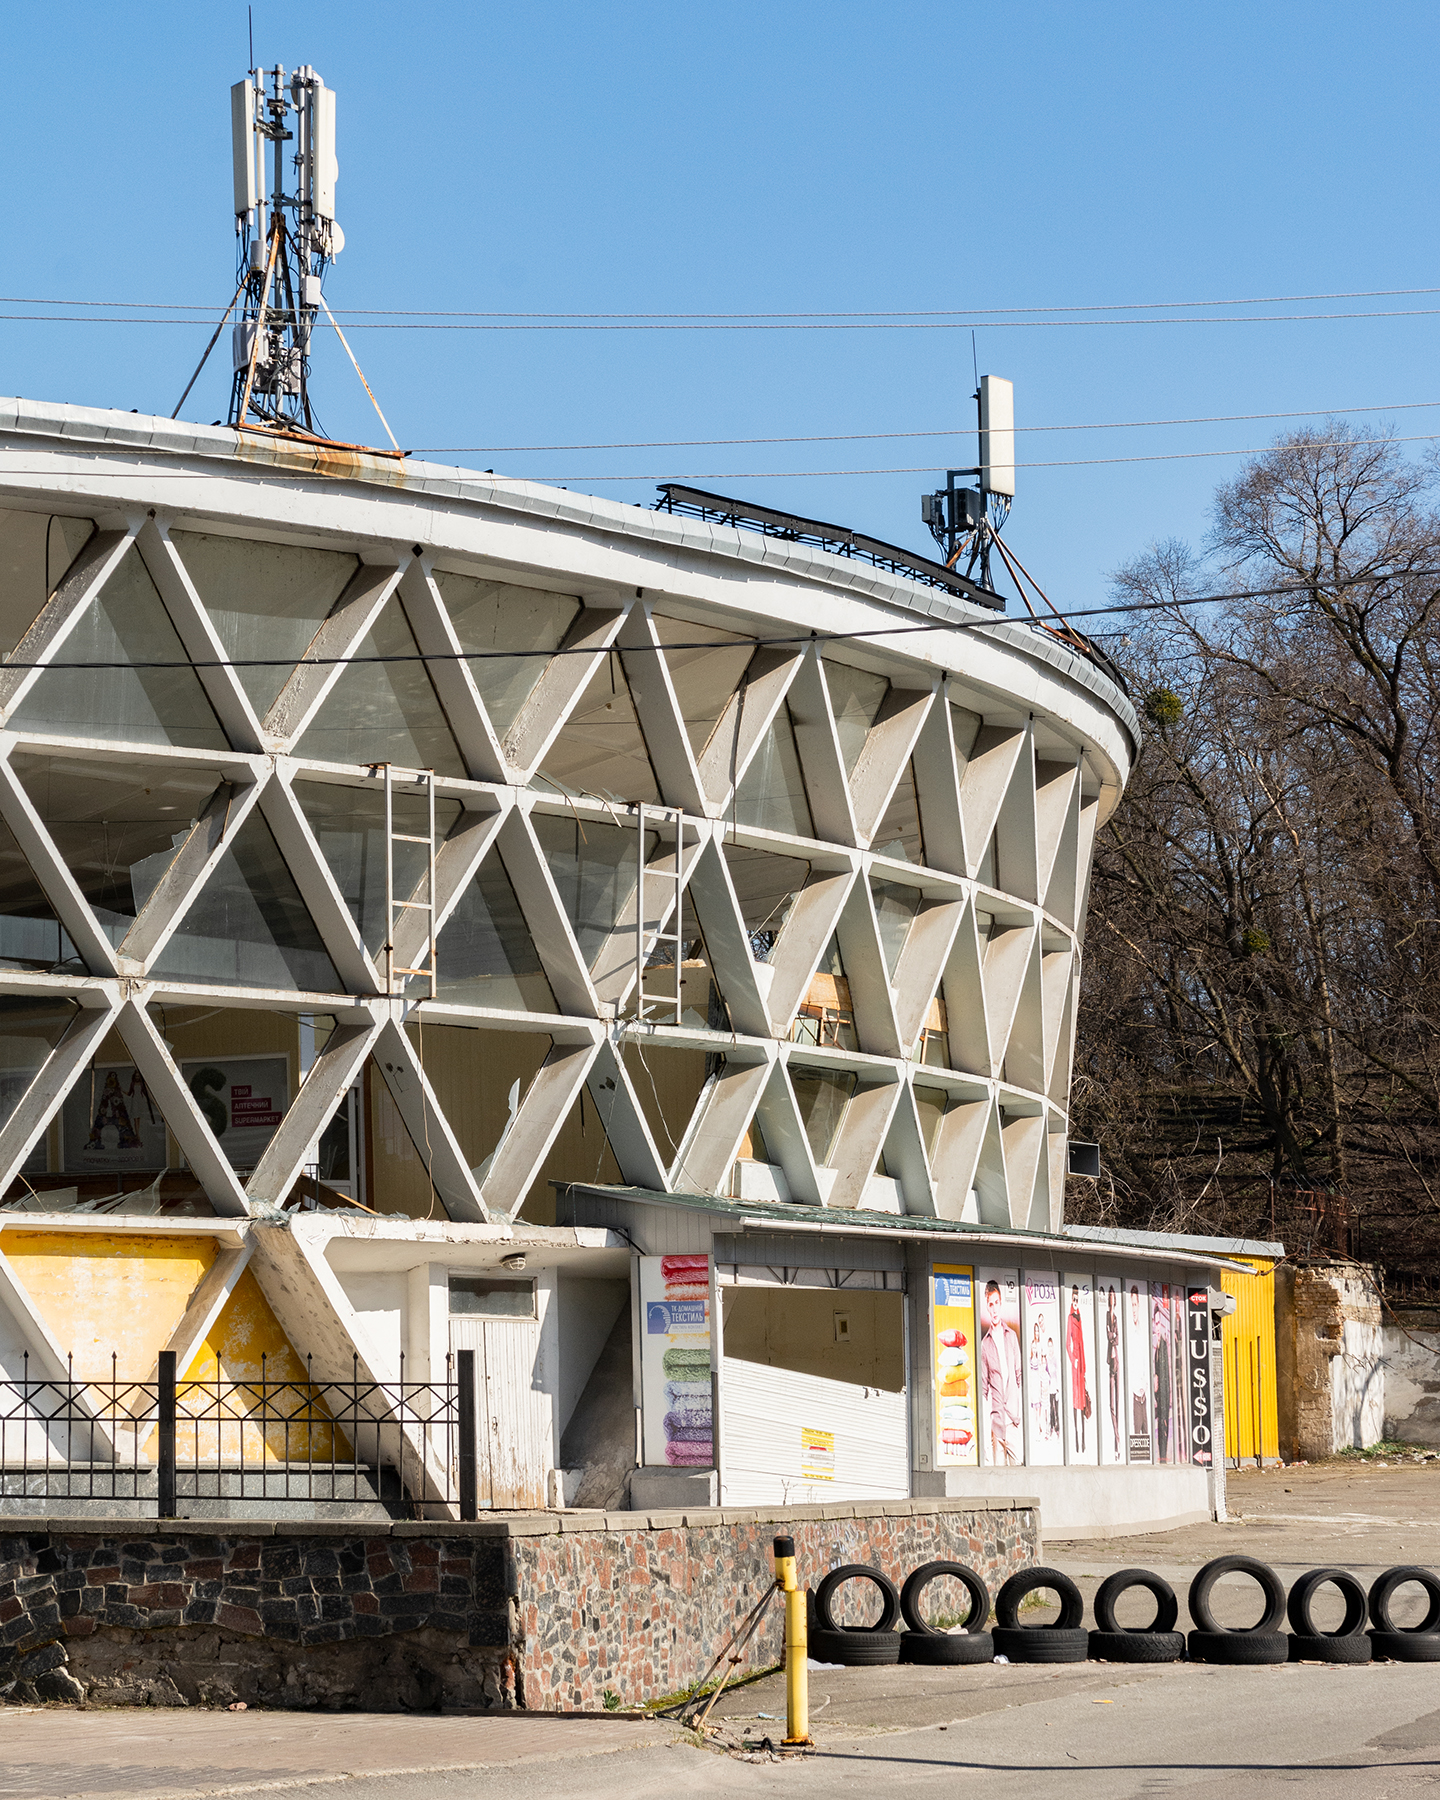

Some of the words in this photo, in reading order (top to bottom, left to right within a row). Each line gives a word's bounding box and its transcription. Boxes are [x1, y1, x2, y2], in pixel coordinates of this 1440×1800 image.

[234, 1100, 269, 1110] АПТЕЧНИЙ
[234, 1115, 280, 1124] SUPERMARKET
[1033, 1283, 1056, 1300] РОЗА
[671, 1312, 703, 1322] ТЕКСТИЛЬ
[1190, 1311, 1210, 1444] TUSSO
